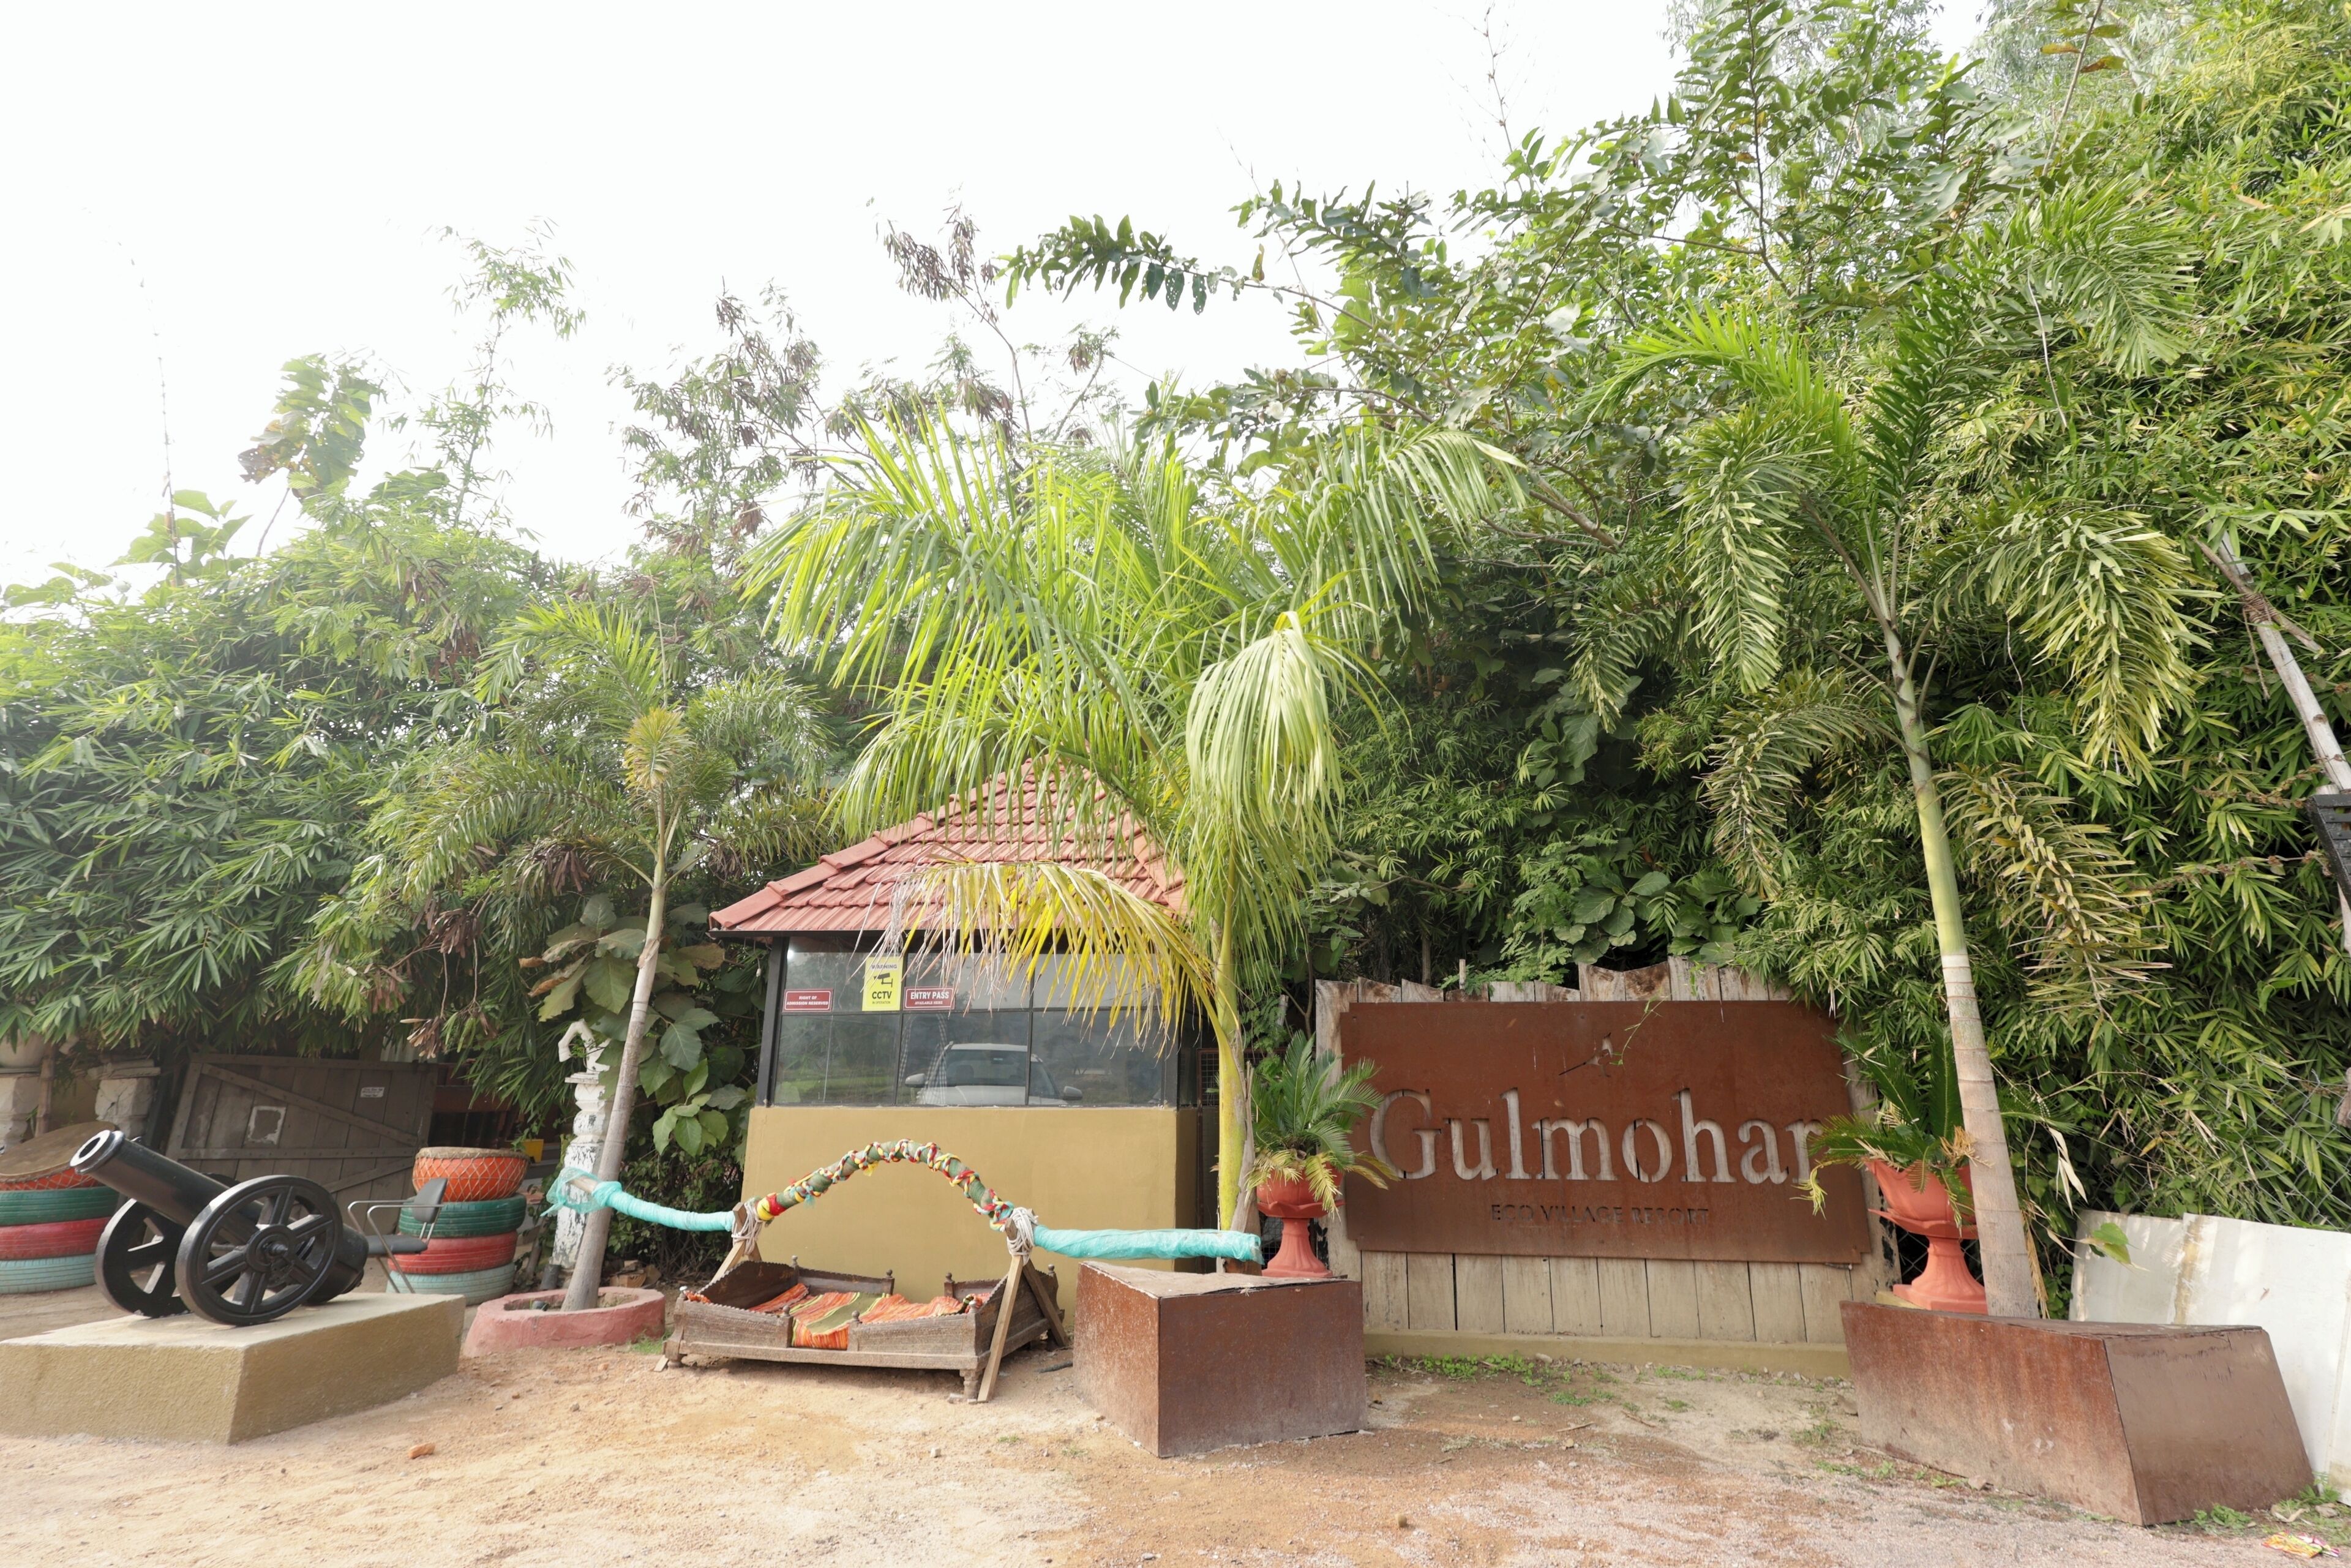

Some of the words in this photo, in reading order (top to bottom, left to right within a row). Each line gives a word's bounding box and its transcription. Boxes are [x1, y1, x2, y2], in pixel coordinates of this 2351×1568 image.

[872, 991, 892, 999] CCTV
[910, 991, 931, 1000] ENTRY
[1370, 1087, 1824, 1184] Gulmohar
[1491, 1204, 1534, 1221] ECO
[1540, 1205, 1624, 1223] VILLAGE
[1631, 1207, 1709, 1225] RESORT
